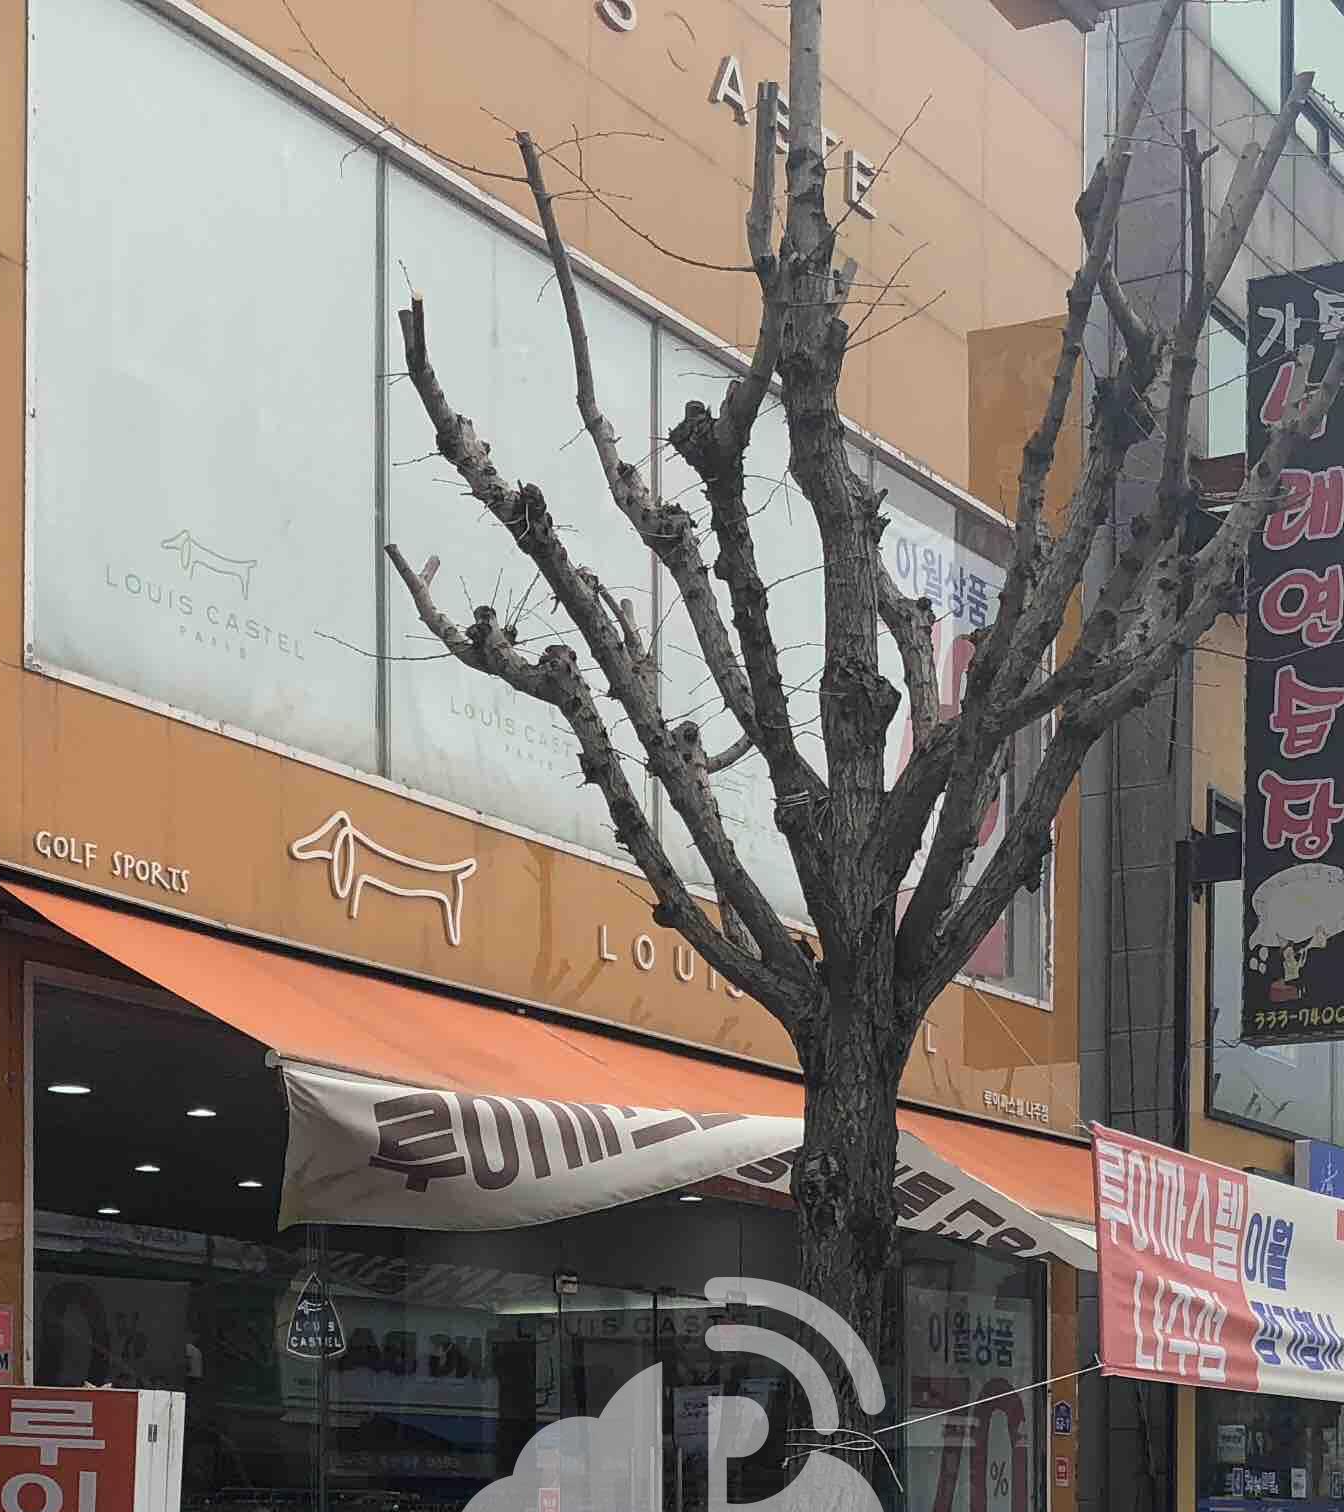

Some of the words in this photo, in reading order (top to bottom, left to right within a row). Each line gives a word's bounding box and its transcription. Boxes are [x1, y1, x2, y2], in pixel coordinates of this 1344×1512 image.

[106, 562, 193, 617] LOUIS
[206, 605, 305, 662] CASTEL
[523, 723, 574, 759] CAST
[34, 830, 97, 870] GOLF
[111, 850, 191, 894] SPORTS
[1098, 1140, 1244, 1283] 루이까스텔
[1242, 1211, 1294, 1292] 이월
[290, 1335, 343, 1349] CASTEL
[1135, 1269, 1230, 1384] 나주점
